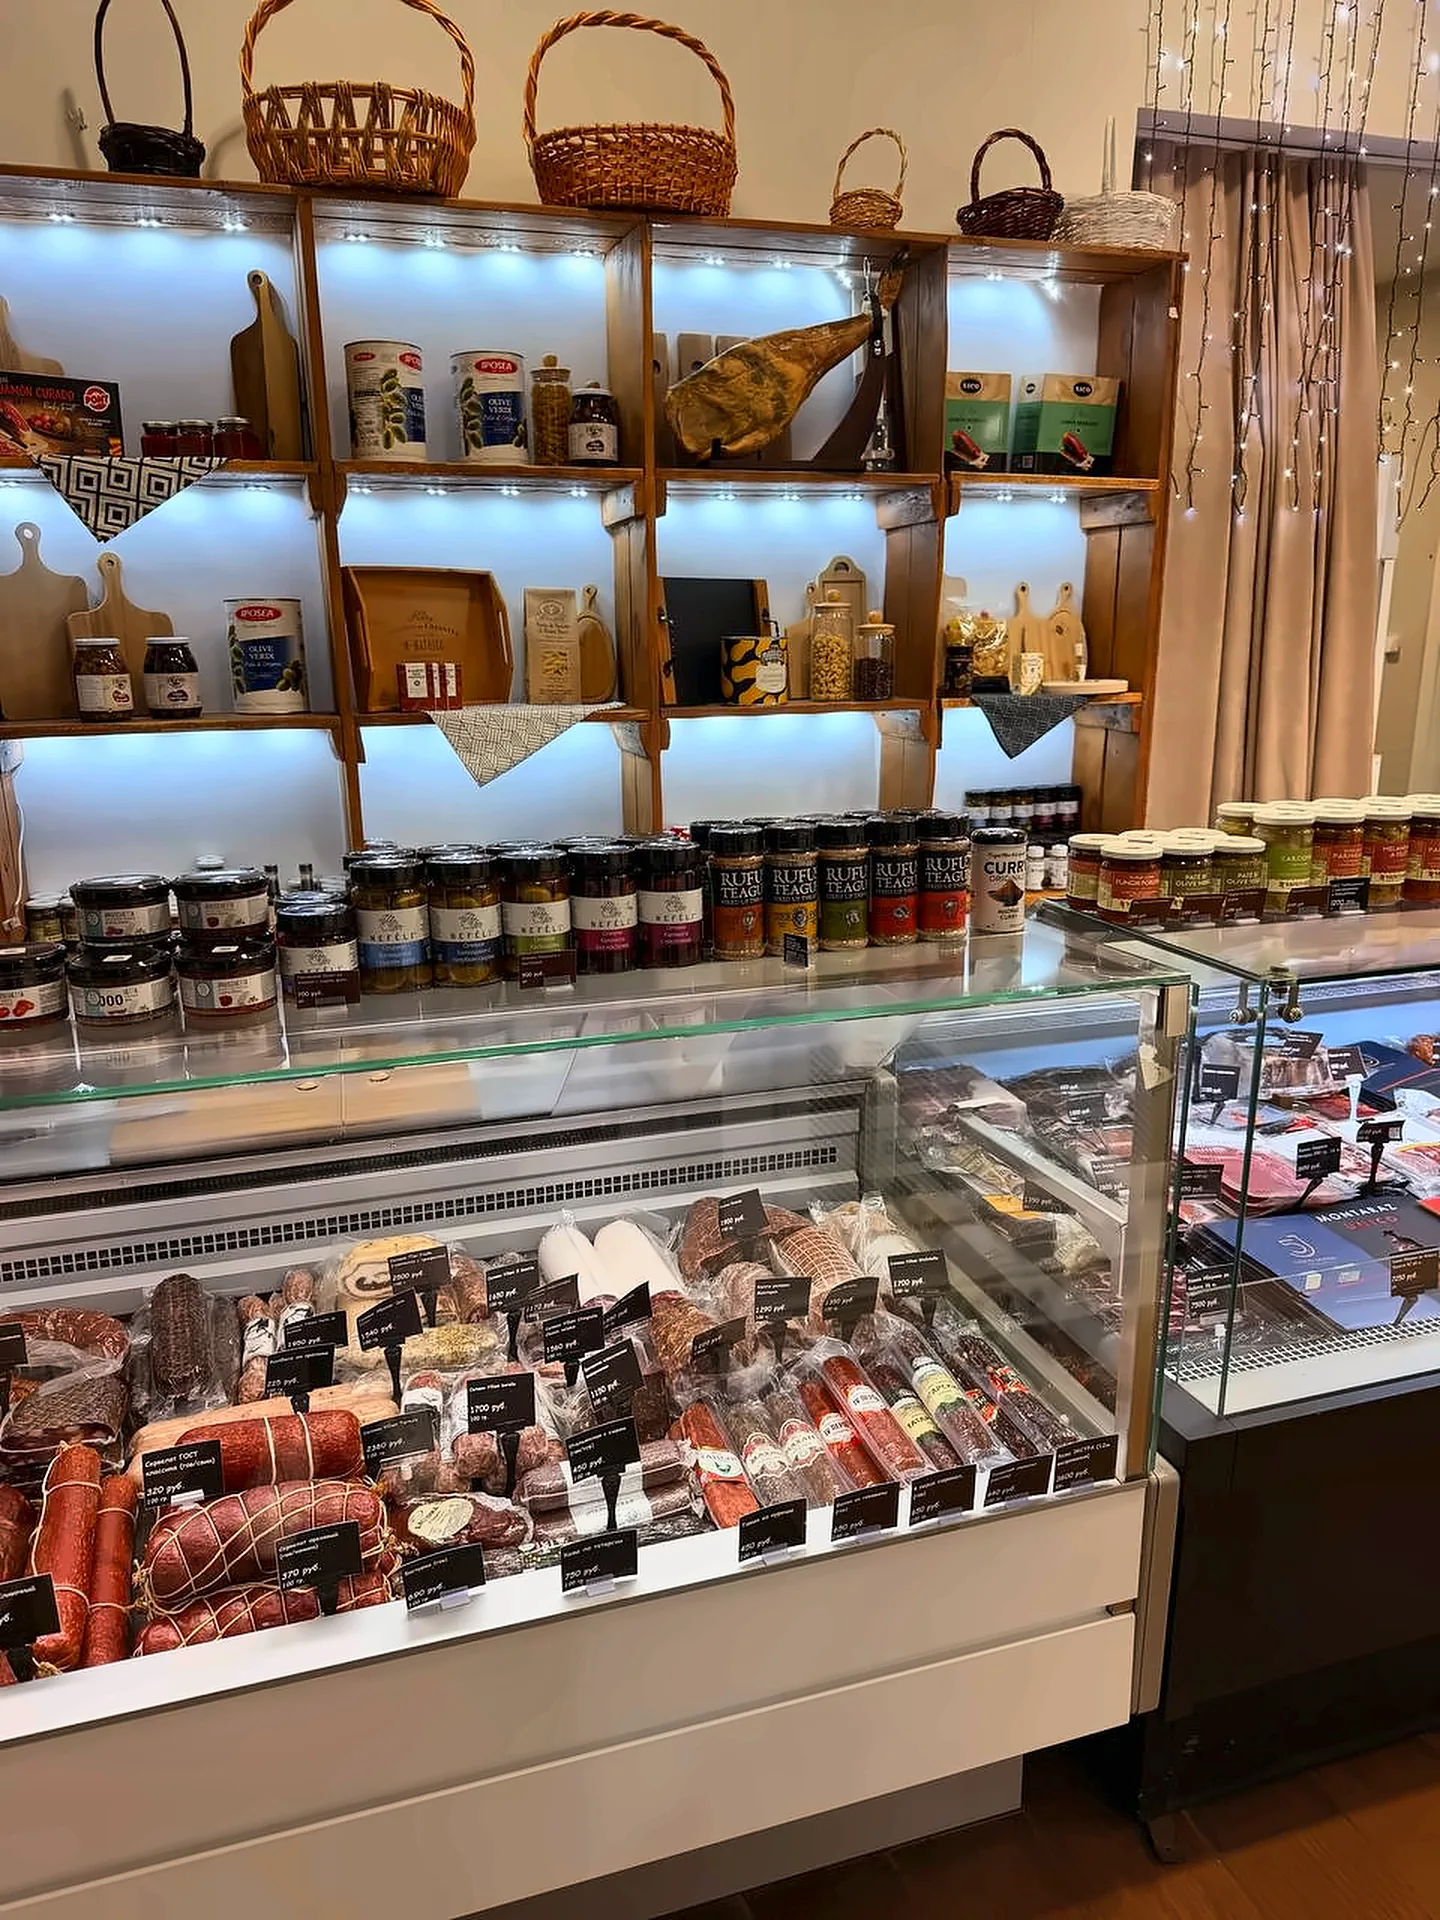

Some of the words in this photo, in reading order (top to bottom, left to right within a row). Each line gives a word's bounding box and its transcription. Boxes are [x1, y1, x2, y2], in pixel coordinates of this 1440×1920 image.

[876, 860, 918, 878] RUFU
[925, 855, 970, 873] RUFU
[984, 860, 1024, 875] CURR
[721, 870, 764, 887] RUFU
[773, 867, 818, 885] RUFU
[826, 864, 868, 882] RUFU
[926, 871, 969, 885] TEAGU
[773, 882, 817, 897] TEAGU
[826, 880, 868, 894] TEAGU
[876, 875, 918, 890] TEAGU
[721, 885, 764, 899] TEAGU
[1315, 1203, 1398, 1223] MONTARAZ
